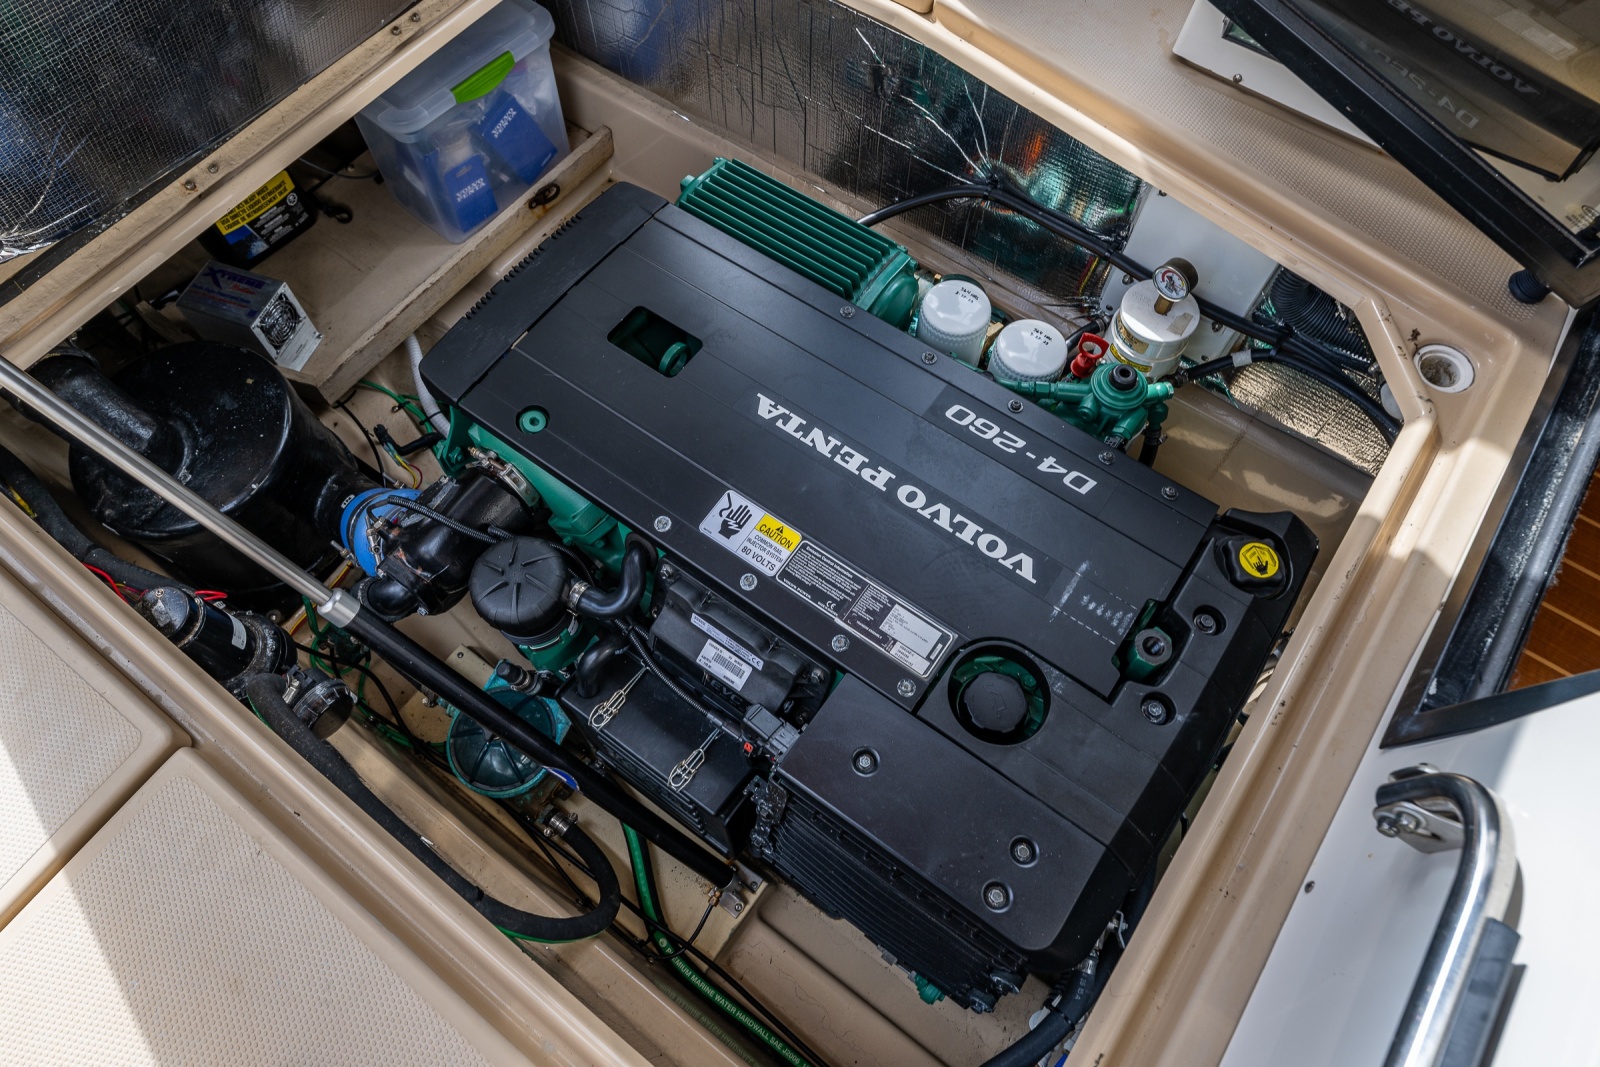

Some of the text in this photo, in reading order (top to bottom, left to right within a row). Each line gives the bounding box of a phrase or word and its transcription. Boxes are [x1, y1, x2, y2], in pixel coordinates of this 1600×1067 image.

[491, 107, 514, 133] VOLVO
[493, 111, 516, 138] PENTA
[455, 177, 483, 196] VOLVO
[457, 182, 485, 202] PENTA
[202, 266, 266, 289] XTREME
[756, 392, 897, 491] PENTA
[945, 404, 1098, 495] D4-260
[753, 534, 783, 555] COMMON RAIL
[758, 523, 793, 549] CAUTION
[897, 484, 1037, 584] VOLVO
[741, 545, 776, 571] 80 VOLTS
[746, 536, 783, 563] INJECTOR SYSTEM
[709, 679, 743, 705] EVC
[690, 974, 715, 997] MARINE
[713, 993, 736, 1013] WATER
[735, 1010, 769, 1040] HARDWALL
[769, 1036, 783, 1049] SAE
